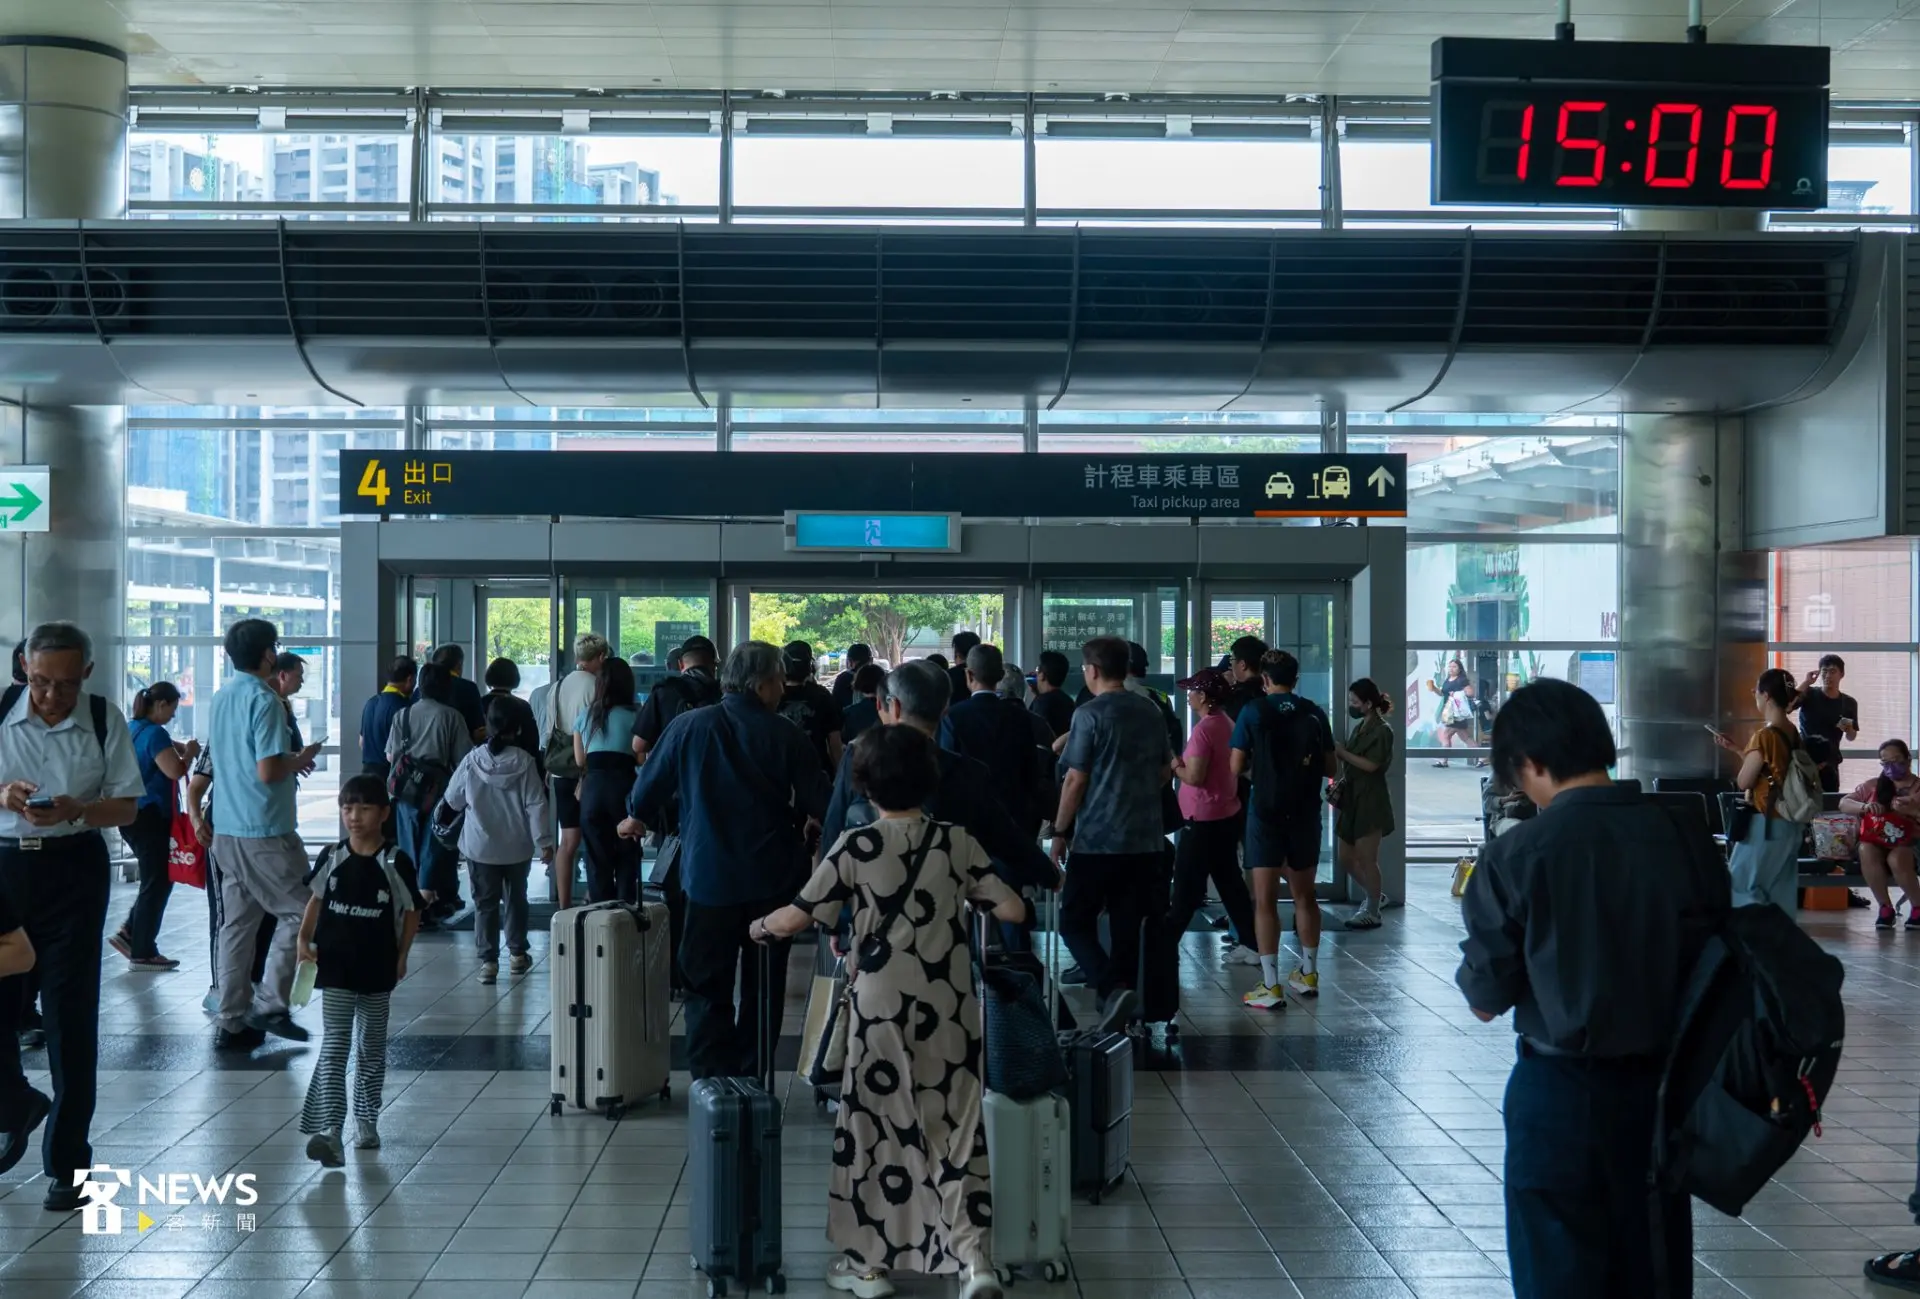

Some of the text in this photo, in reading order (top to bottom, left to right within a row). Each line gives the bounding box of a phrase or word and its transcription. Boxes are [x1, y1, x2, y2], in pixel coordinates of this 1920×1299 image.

[1516, 101, 1778, 189] 15:00
[357, 459, 391, 506] 4
[404, 459, 452, 485] 出口
[1084, 463, 1240, 489] 計程車乘車區
[404, 489, 432, 504] Exit
[1131, 495, 1240, 511] Taxi pickup area
[328, 900, 384, 918] Light Chaser
